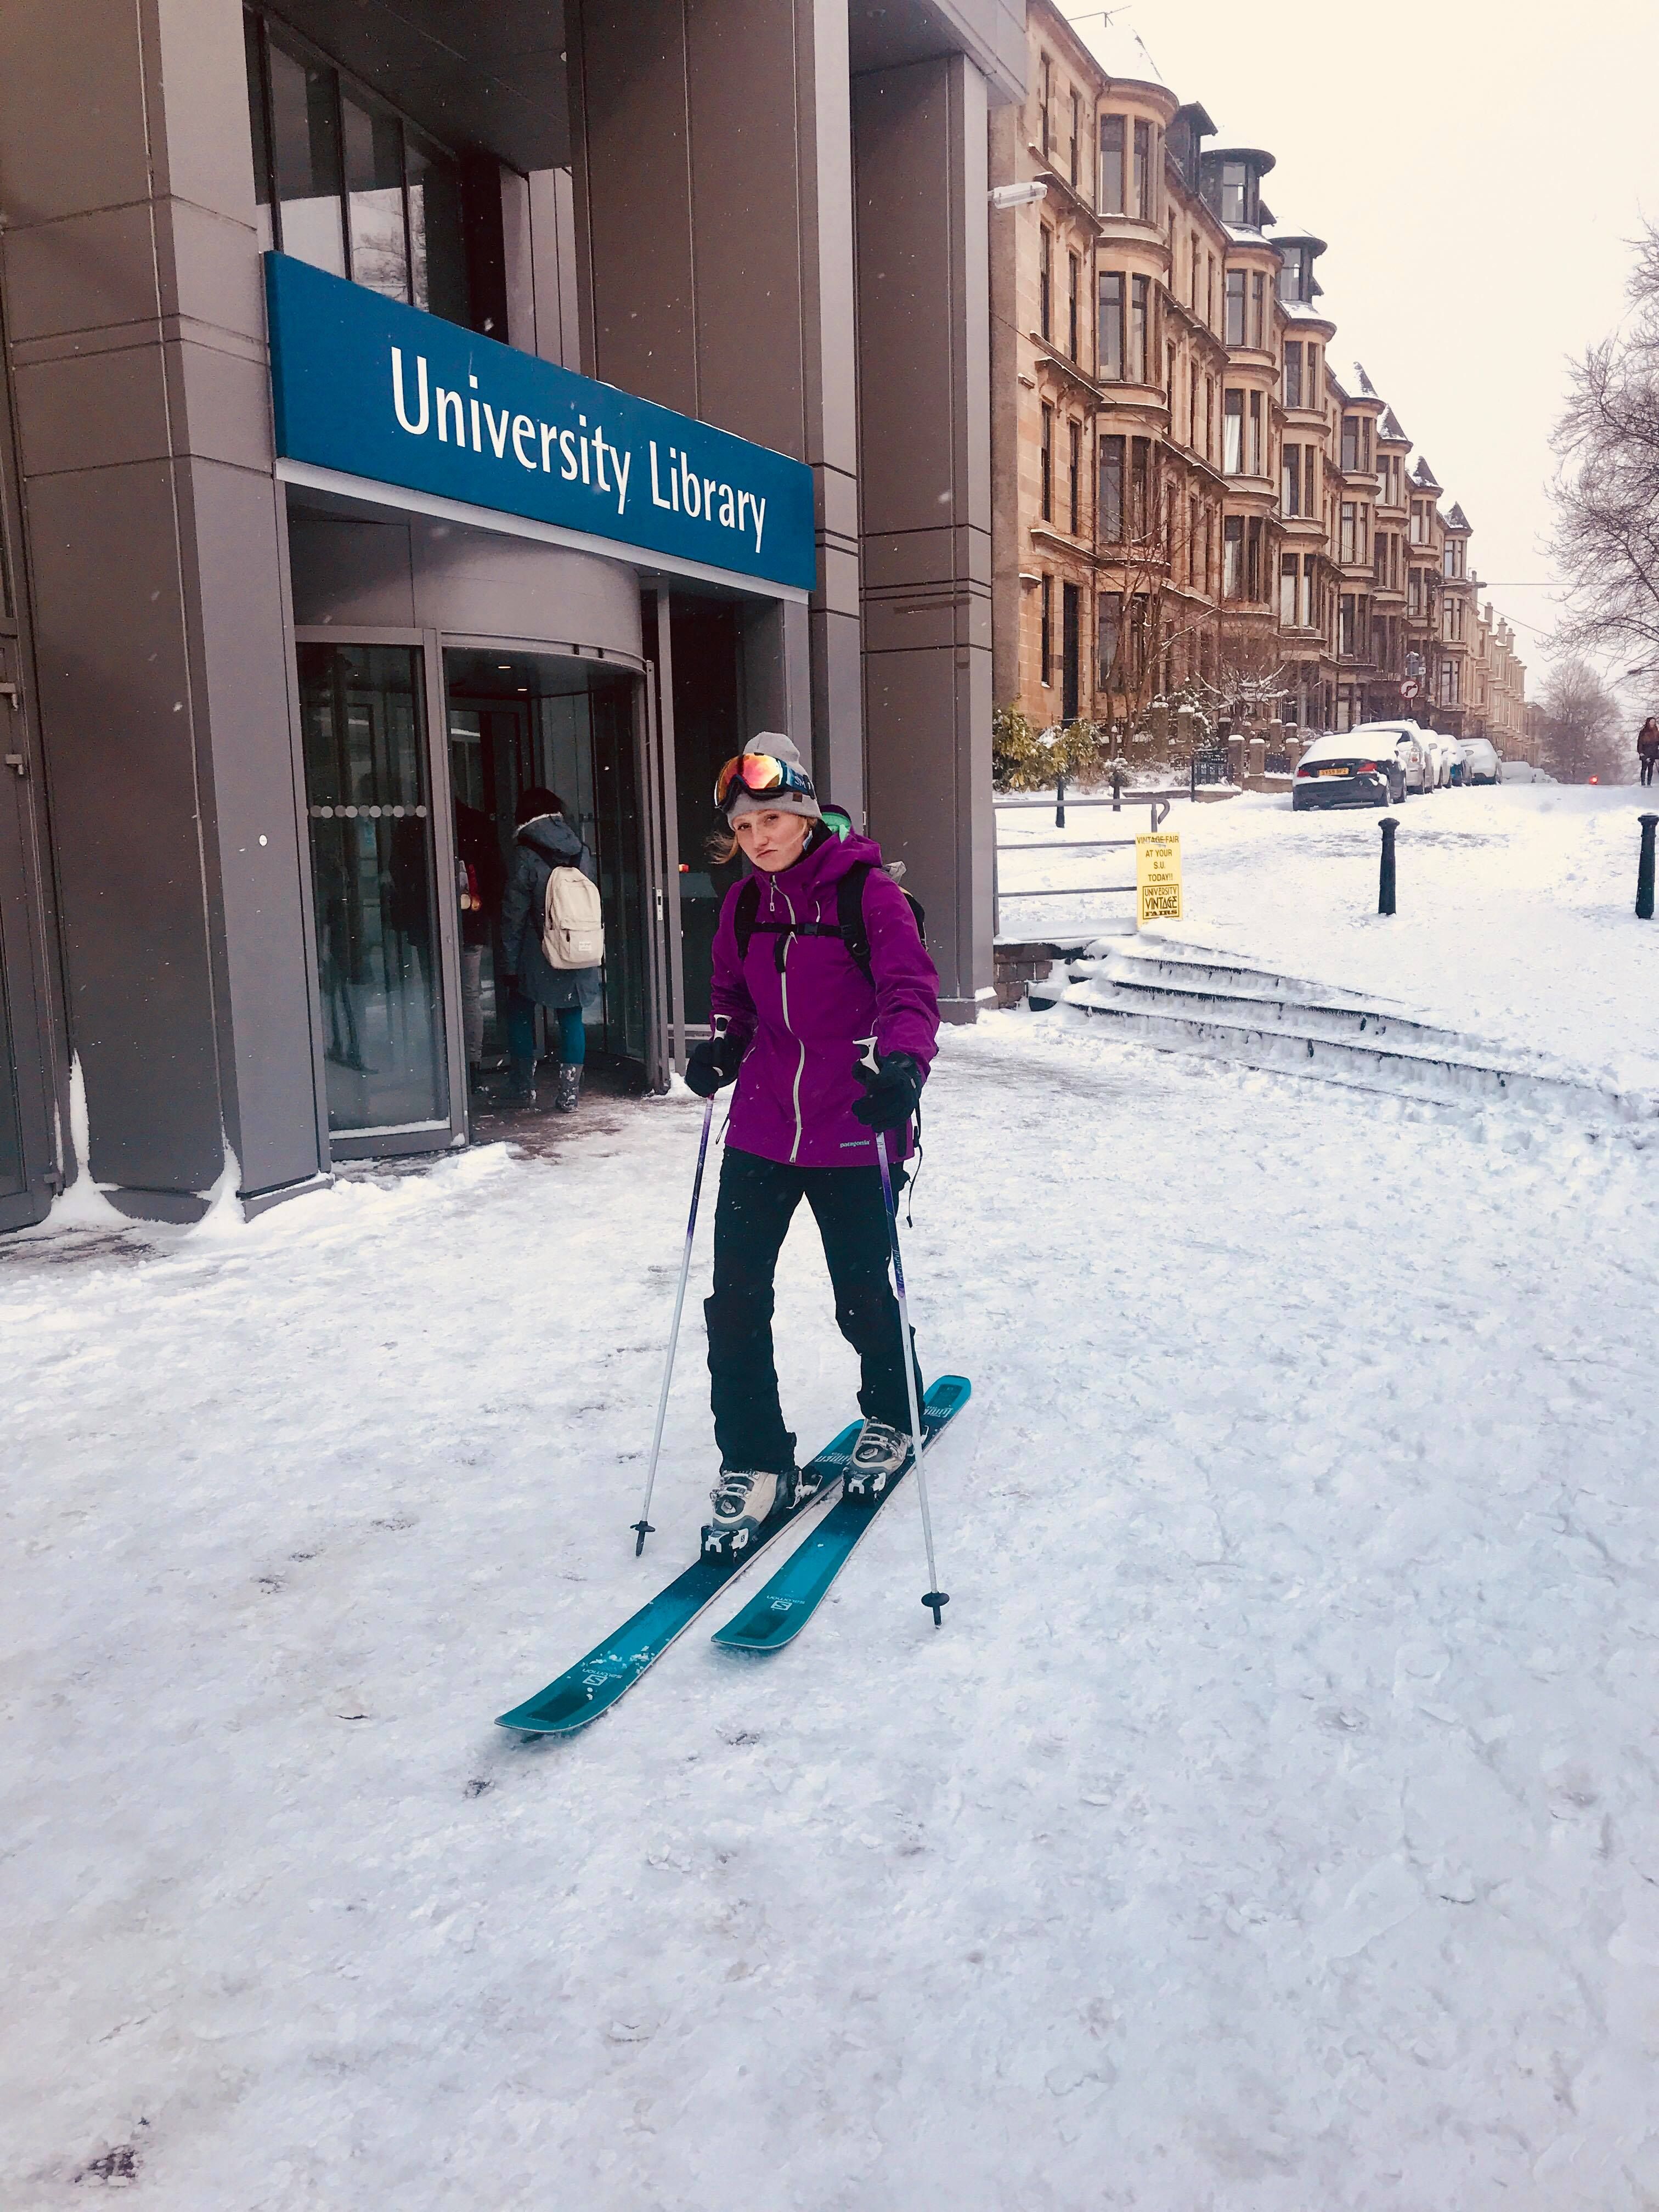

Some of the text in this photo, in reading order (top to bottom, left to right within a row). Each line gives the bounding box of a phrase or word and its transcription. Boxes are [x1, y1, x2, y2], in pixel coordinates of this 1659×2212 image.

[391, 346, 766, 553] University Library
[1148, 873, 1173, 882] TODAY!!
[1145, 887, 1177, 896] UNIVERSITY
[1145, 896, 1177, 910] VINTAGE
[840, 1140, 870, 1148] patagonia
